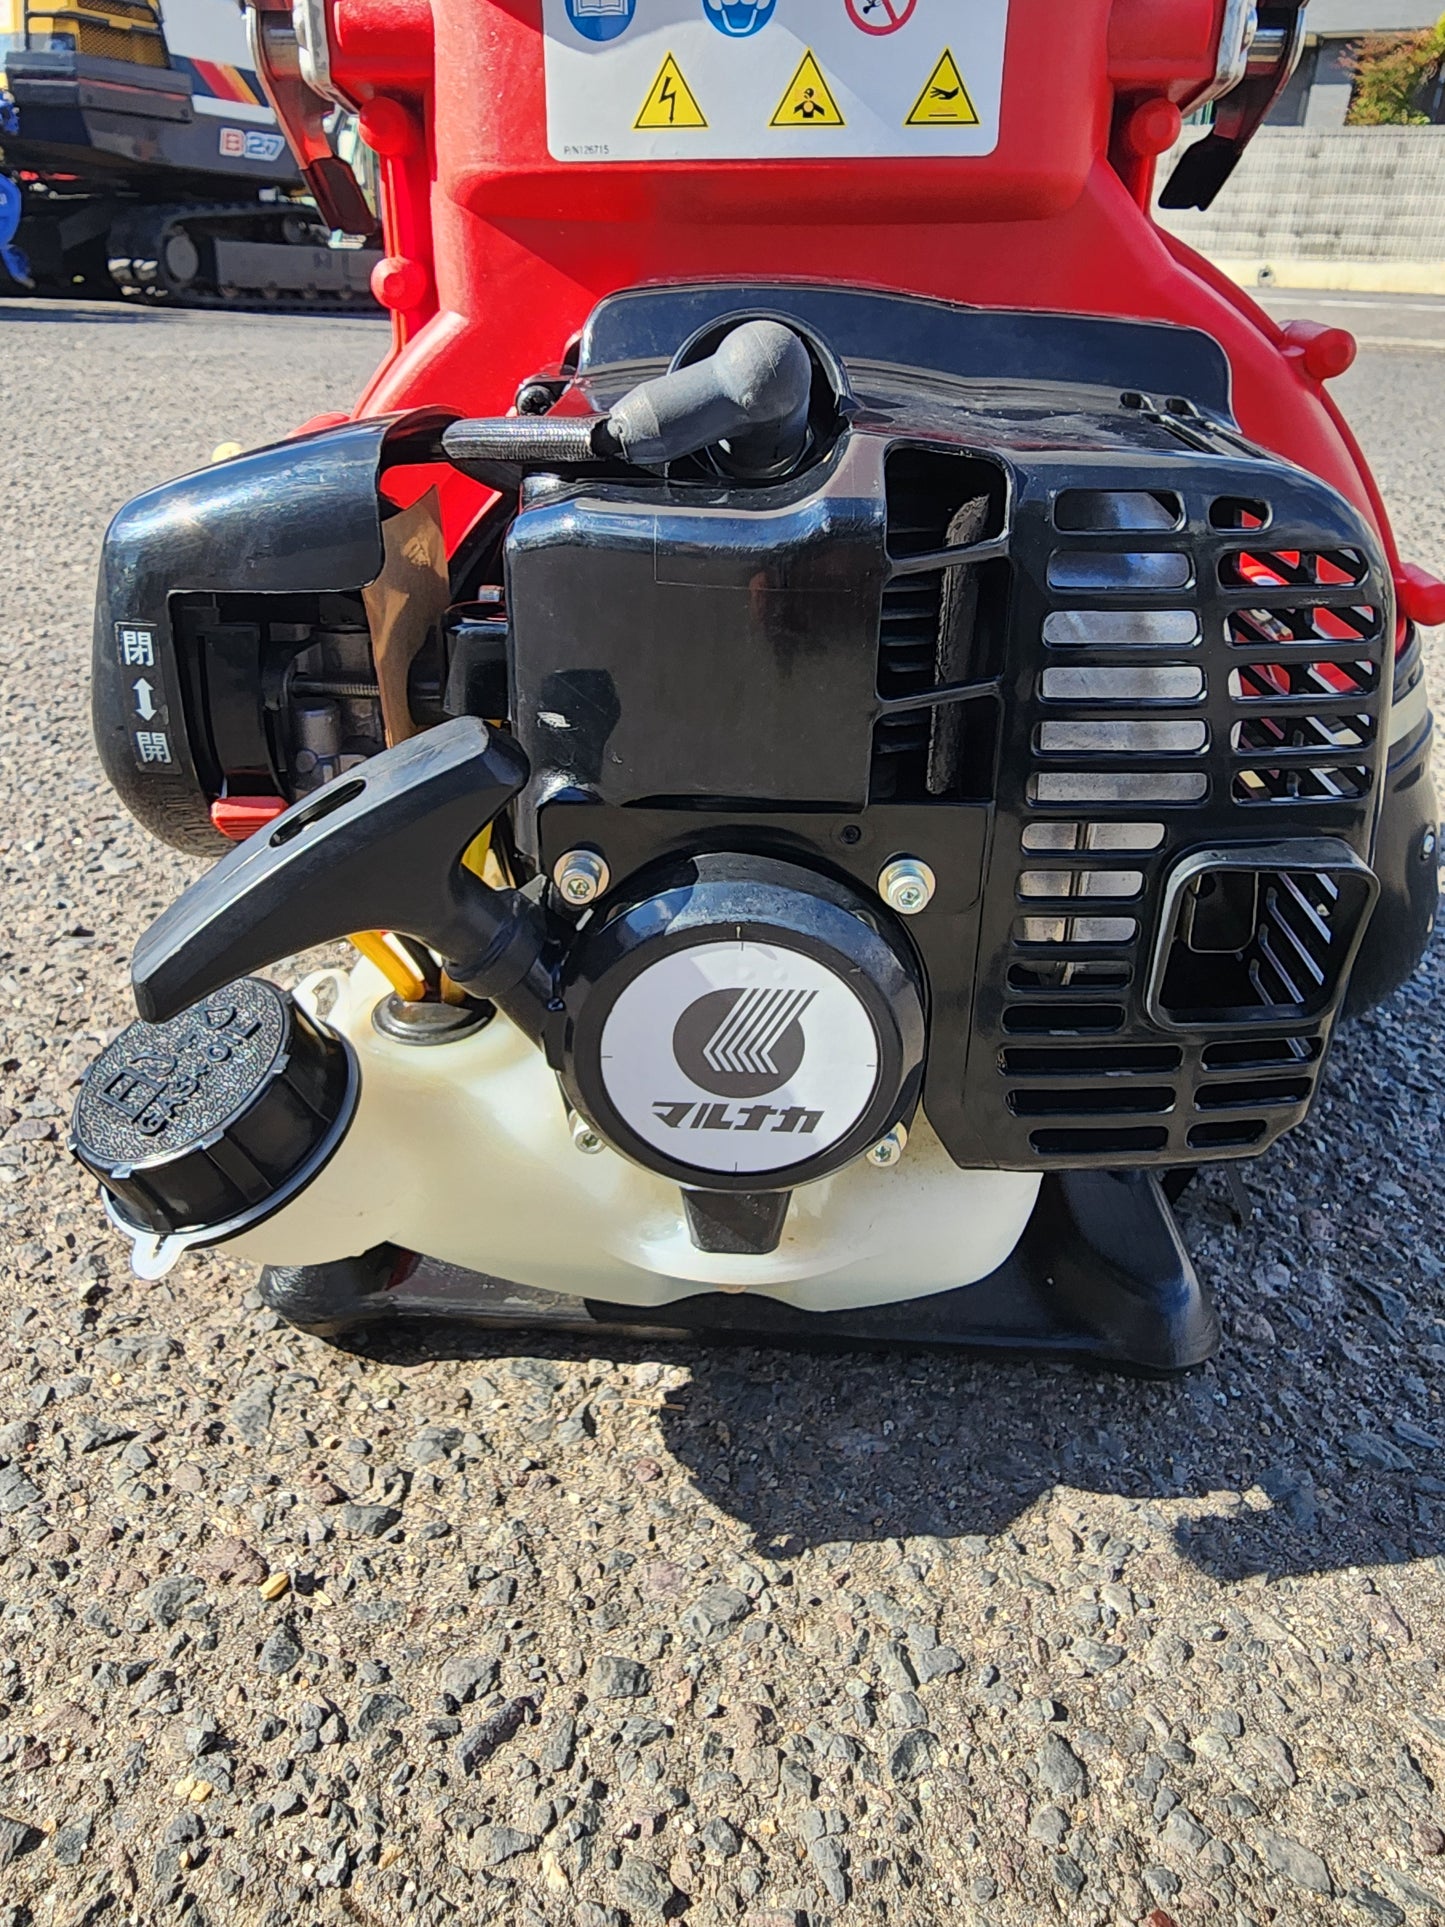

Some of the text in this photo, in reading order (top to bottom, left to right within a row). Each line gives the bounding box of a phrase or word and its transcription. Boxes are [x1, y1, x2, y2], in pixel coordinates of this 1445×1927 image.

[219, 128, 285, 161] B27
[122, 630, 155, 666] 閉
[136, 731, 172, 764] 開
[651, 1101, 825, 1134] マルナカ
